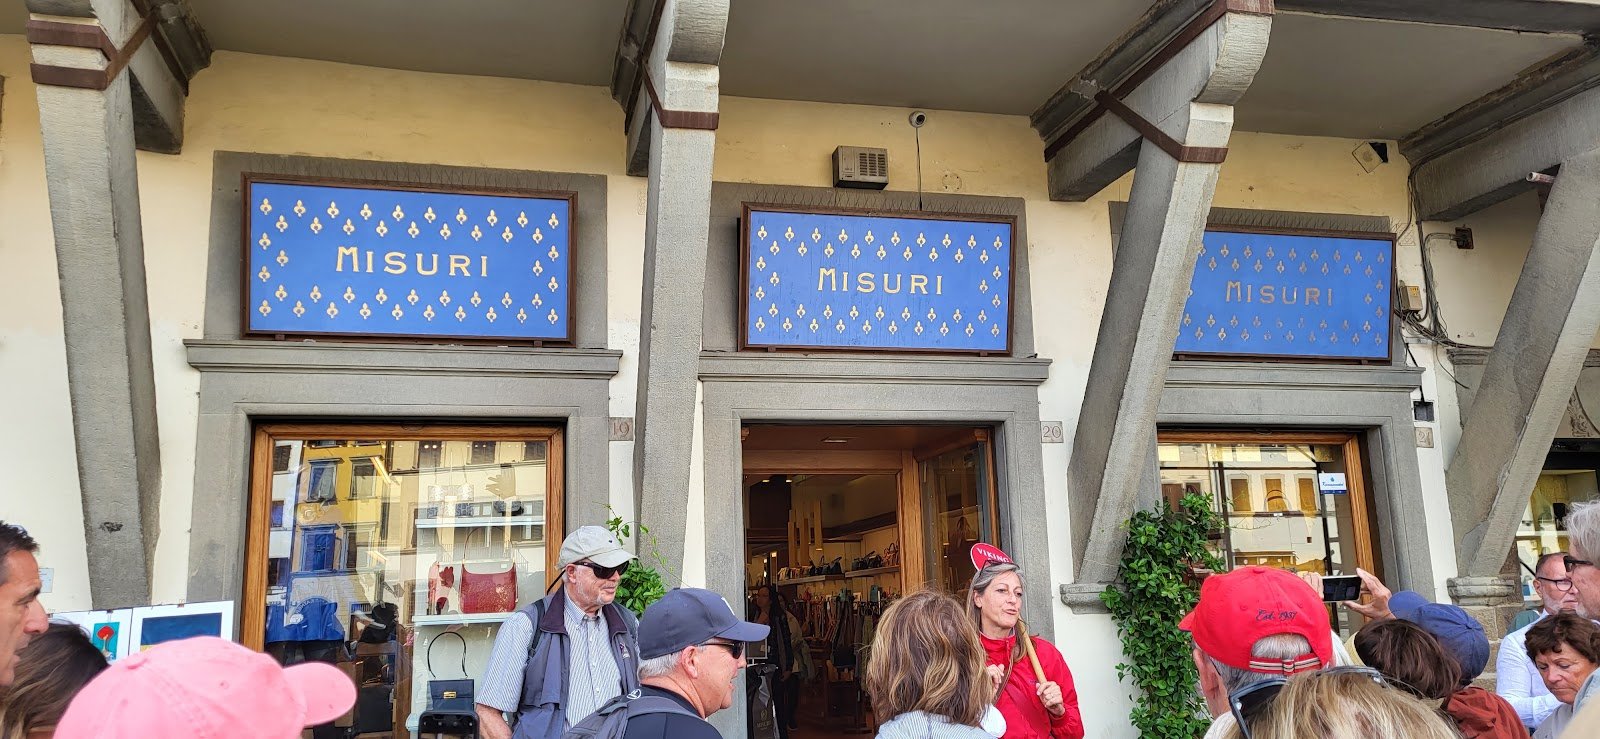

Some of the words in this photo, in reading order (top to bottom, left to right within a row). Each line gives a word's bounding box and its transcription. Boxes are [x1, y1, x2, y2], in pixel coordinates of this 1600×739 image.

[335, 245, 489, 278] MISURI
[817, 266, 944, 296] MISURI
[1225, 279, 1334, 307] MISURI
[613, 421, 630, 438] 19
[1042, 425, 1062, 439] 20
